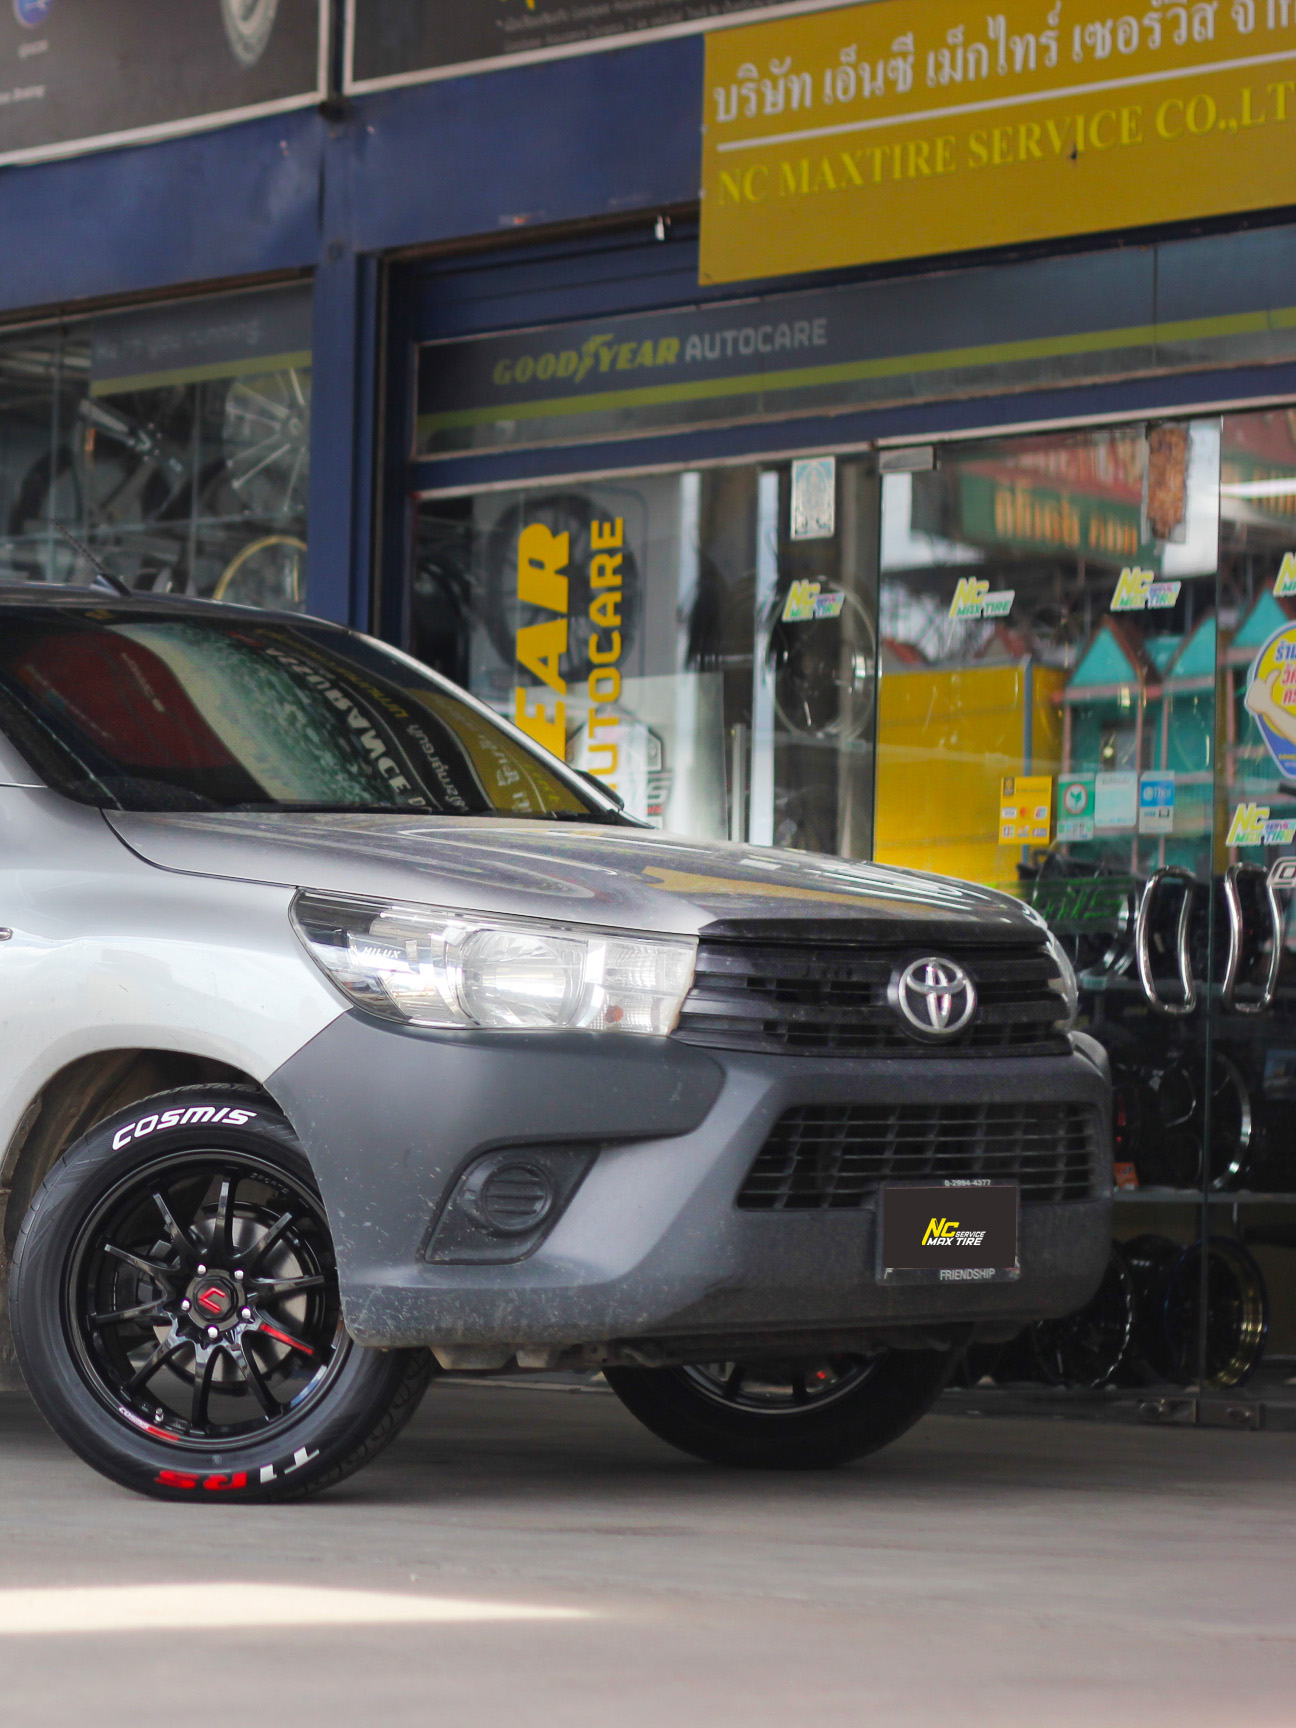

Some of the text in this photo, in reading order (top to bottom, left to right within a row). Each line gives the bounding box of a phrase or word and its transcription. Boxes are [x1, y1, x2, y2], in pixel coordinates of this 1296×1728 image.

[714, 55, 813, 123] บริษัท
[823, 31, 916, 105] เอ็นซี
[716, 81, 1296, 205] NC MAXTIRE SERVICE CO.,LT
[492, 317, 829, 385] GOODYEAR AUTOCARE
[949, 576, 989, 618] NC
[588, 516, 624, 792] UTOCARE
[111, 1106, 257, 1151] COSMIS
[939, 1268, 996, 1281] FRIENDSHIP
